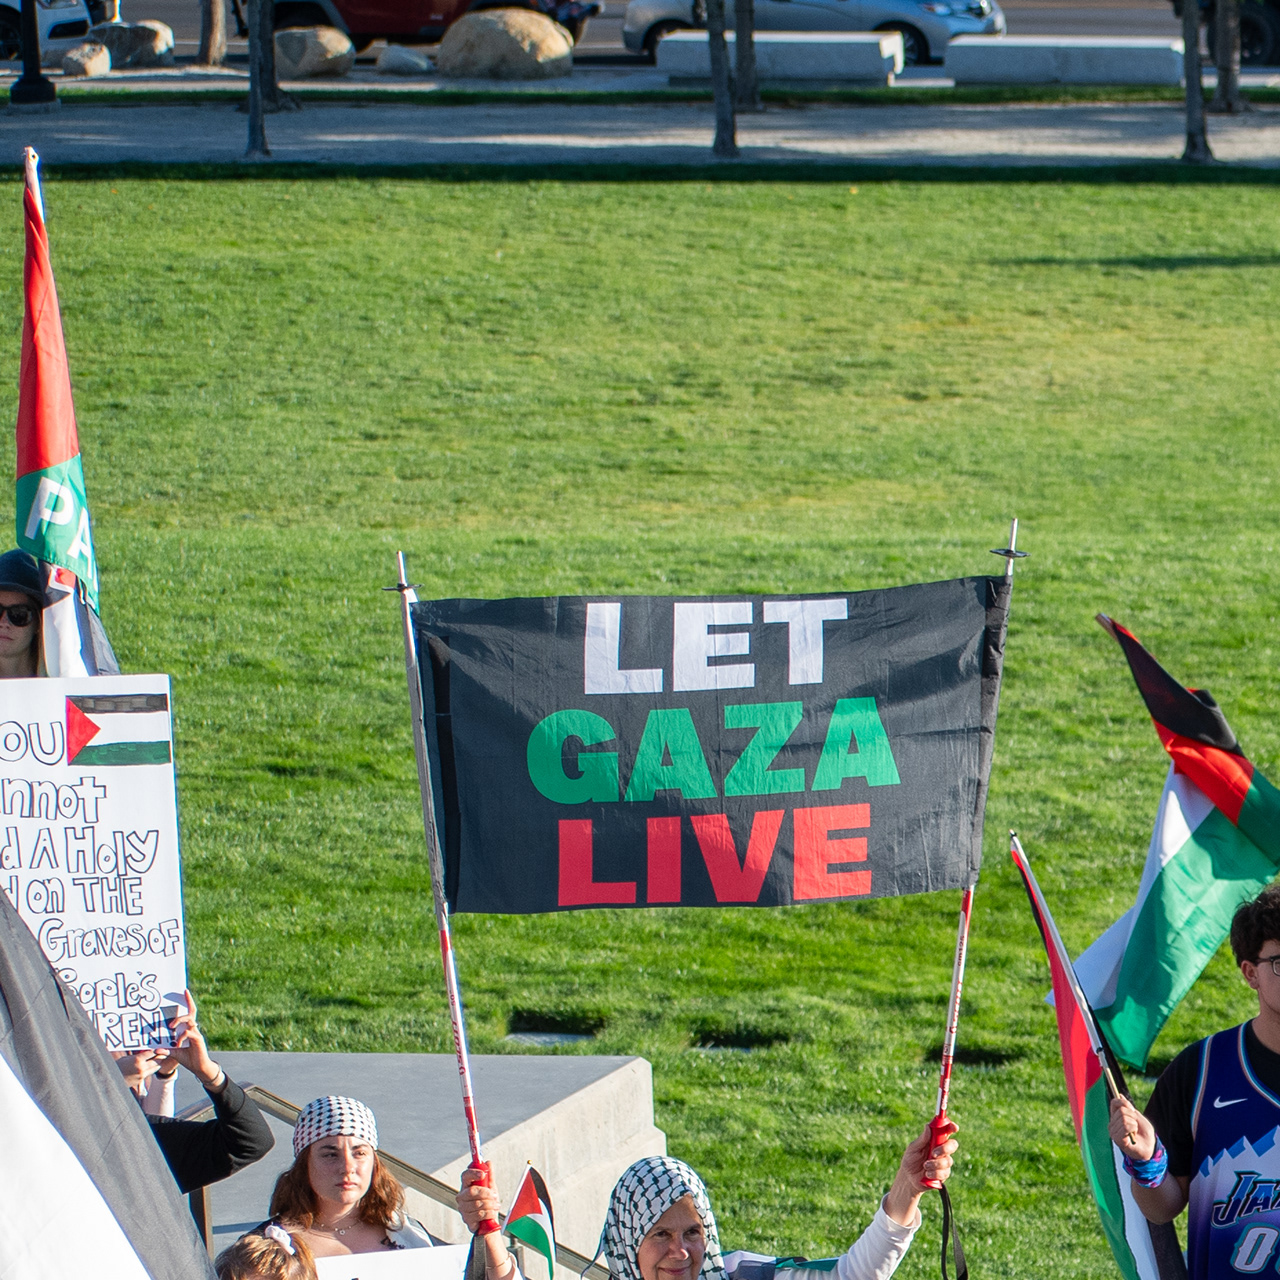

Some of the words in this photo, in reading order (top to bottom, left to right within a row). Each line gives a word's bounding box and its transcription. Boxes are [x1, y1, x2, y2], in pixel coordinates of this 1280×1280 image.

[584, 598, 848, 695] LET
[0, 721, 65, 766] OU
[526, 696, 901, 804] GAZA
[1, 776, 107, 824] nnot
[557, 803, 872, 907] LIVE
[73, 877, 143, 915] THE
[38, 918, 147, 962] Graves
